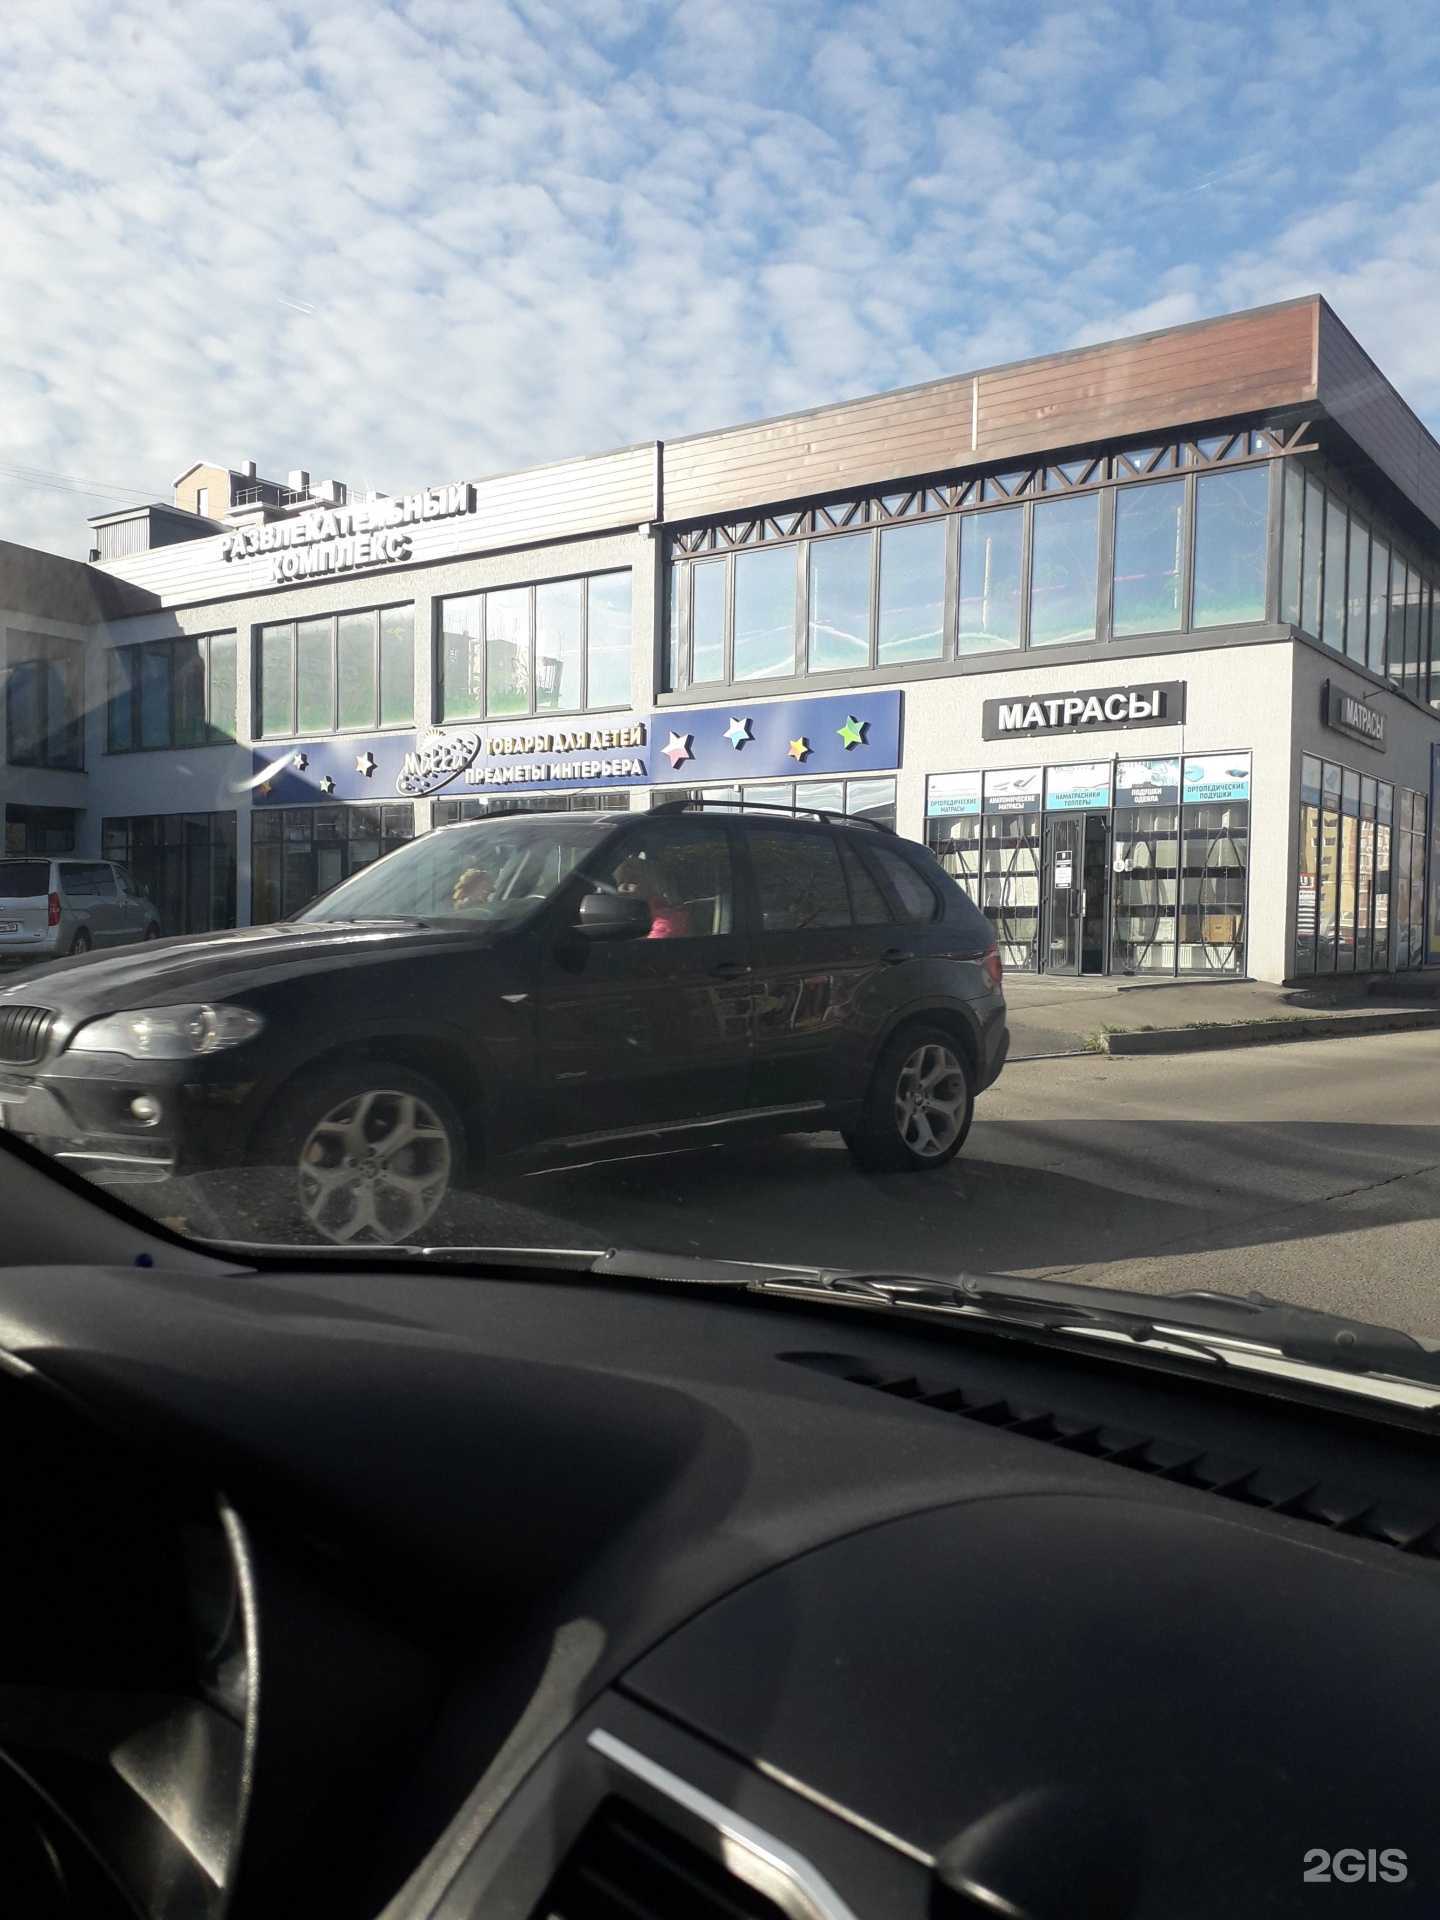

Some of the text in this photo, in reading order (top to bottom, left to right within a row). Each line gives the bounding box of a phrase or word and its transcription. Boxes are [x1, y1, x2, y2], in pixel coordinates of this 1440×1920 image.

[270, 532, 413, 583] КОМПЛЕКС
[997, 690, 1166, 732] МАТРАСЫ
[1342, 696, 1386, 742] МАТРАСЫ
[485, 721, 647, 756] ТОВАРЫ ДЛЯ ДЕТЕЙ
[465, 757, 647, 786] ПРЕДМЕТЫ ИНТЕРЬЕРА
[930, 798, 977, 807] ОРТОПЕДИЧЕСКИЕ
[1055, 791, 1101, 800] НАМАТРАСНИКИ
[1187, 783, 1245, 793] ОРТОПЕДИЧЕСКИЕ
[1199, 791, 1232, 799] ПОДУШКИ
